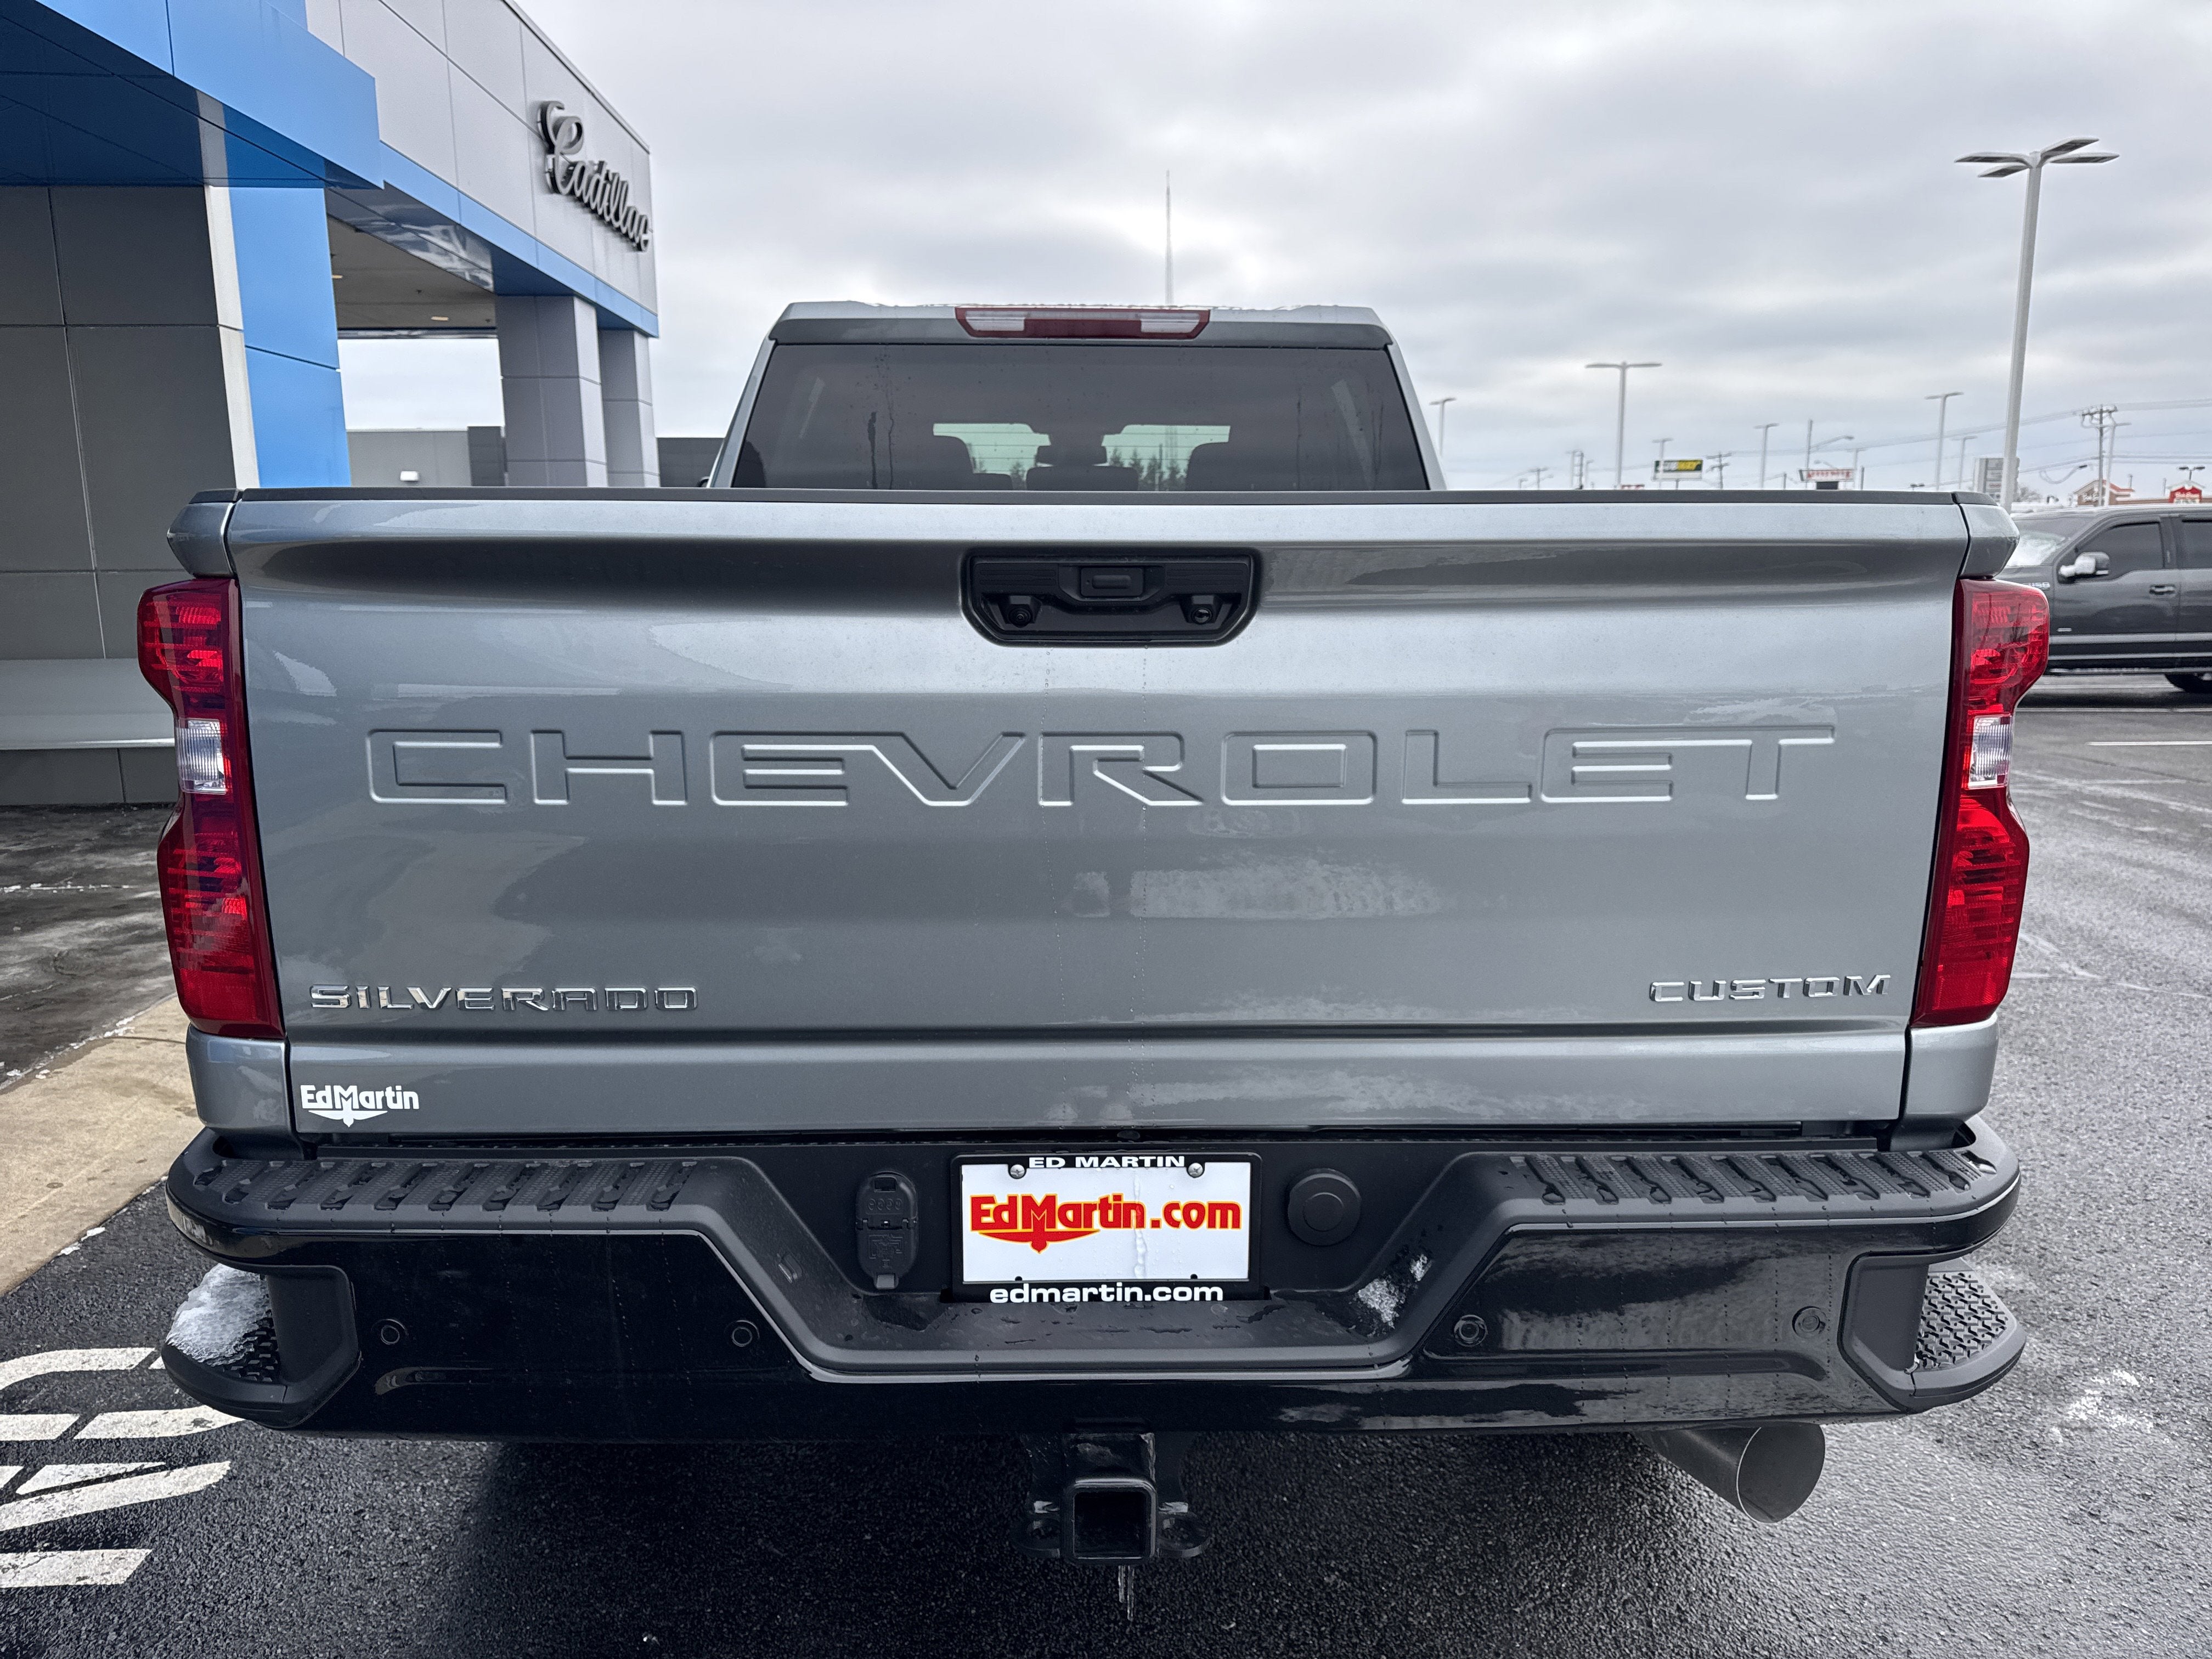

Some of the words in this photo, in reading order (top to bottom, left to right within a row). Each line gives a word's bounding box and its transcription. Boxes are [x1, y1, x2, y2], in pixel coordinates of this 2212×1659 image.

[537, 100, 650, 251] Cadillac
[366, 725, 1836, 806] CHEVROLET
[309, 985, 698, 1011] SILVERADO
[1650, 974, 1891, 1002] CUSTOM
[1029, 1157, 1065, 1169] ED
[1075, 1156, 1186, 1167] MARTIN
[970, 1193, 1242, 1233] EdMartin.com
[990, 1283, 1223, 1304] edmartin.com
